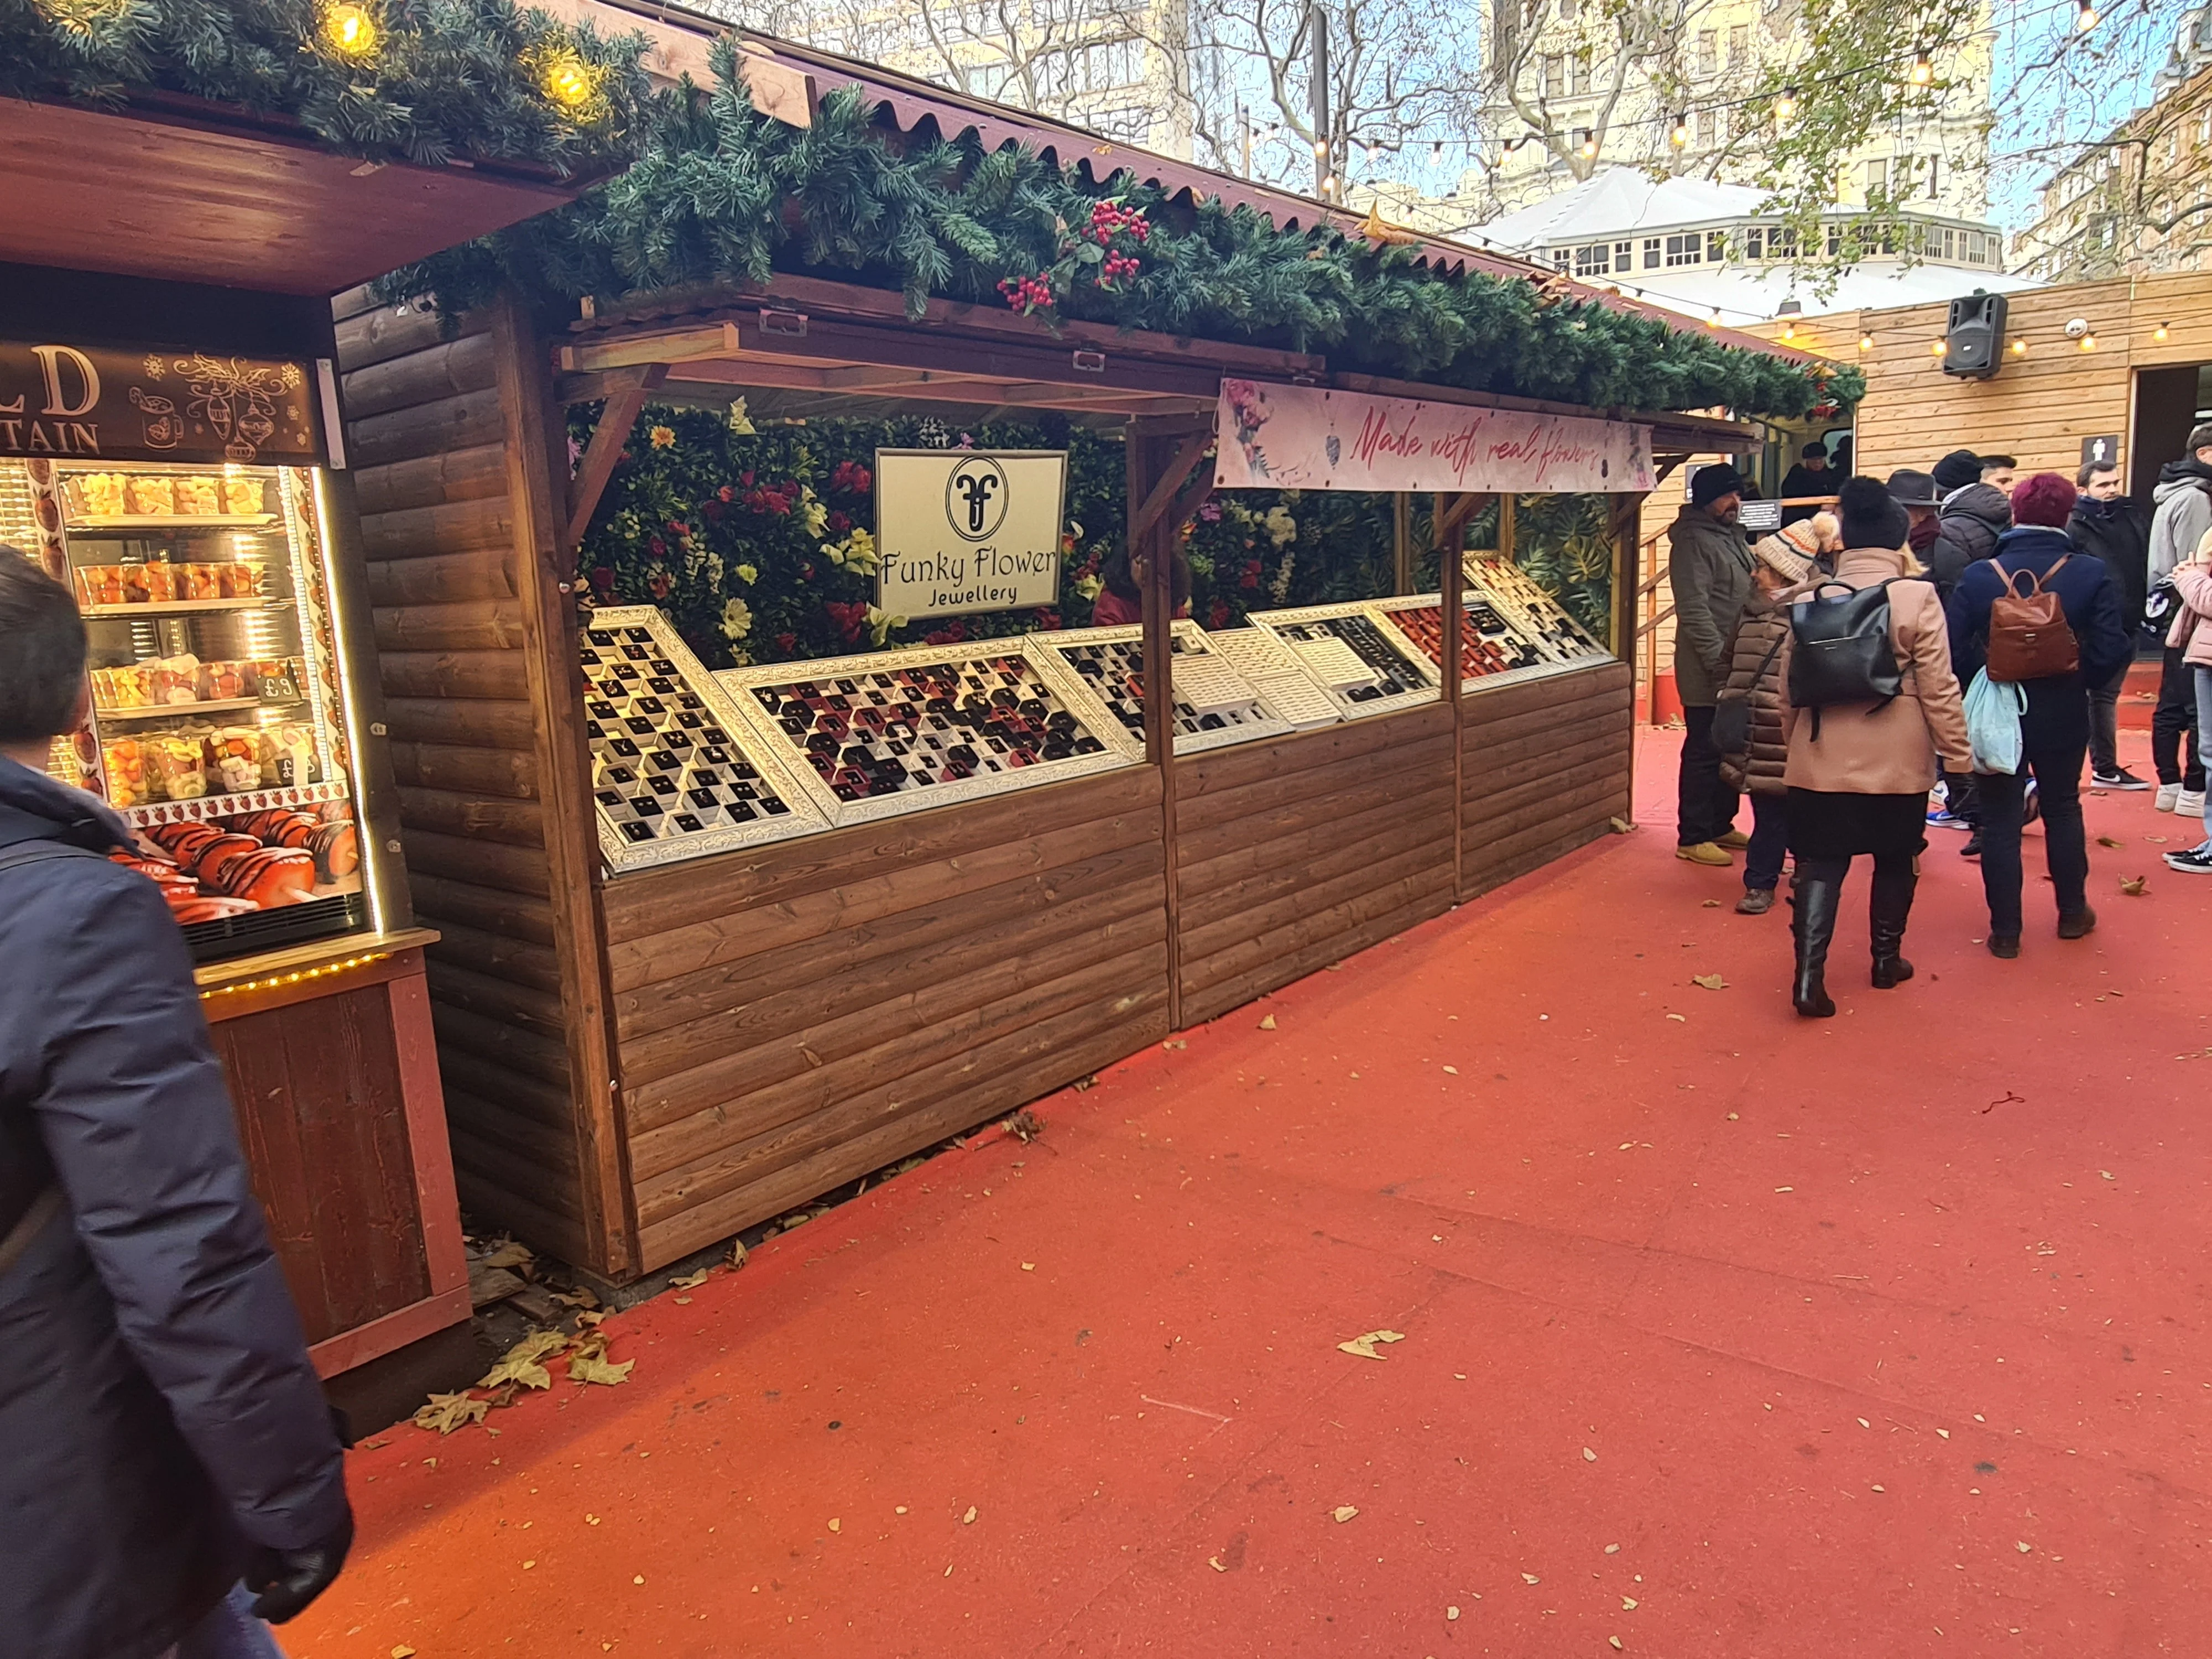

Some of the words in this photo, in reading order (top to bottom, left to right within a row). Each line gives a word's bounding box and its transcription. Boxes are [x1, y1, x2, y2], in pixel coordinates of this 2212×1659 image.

[1349, 406, 1423, 471] Made
[1431, 416, 1482, 487] with
[1486, 424, 1537, 463] real
[880, 550, 964, 588] Funky
[974, 545, 1056, 577] Flower
[928, 585, 1017, 607] Jewellery
